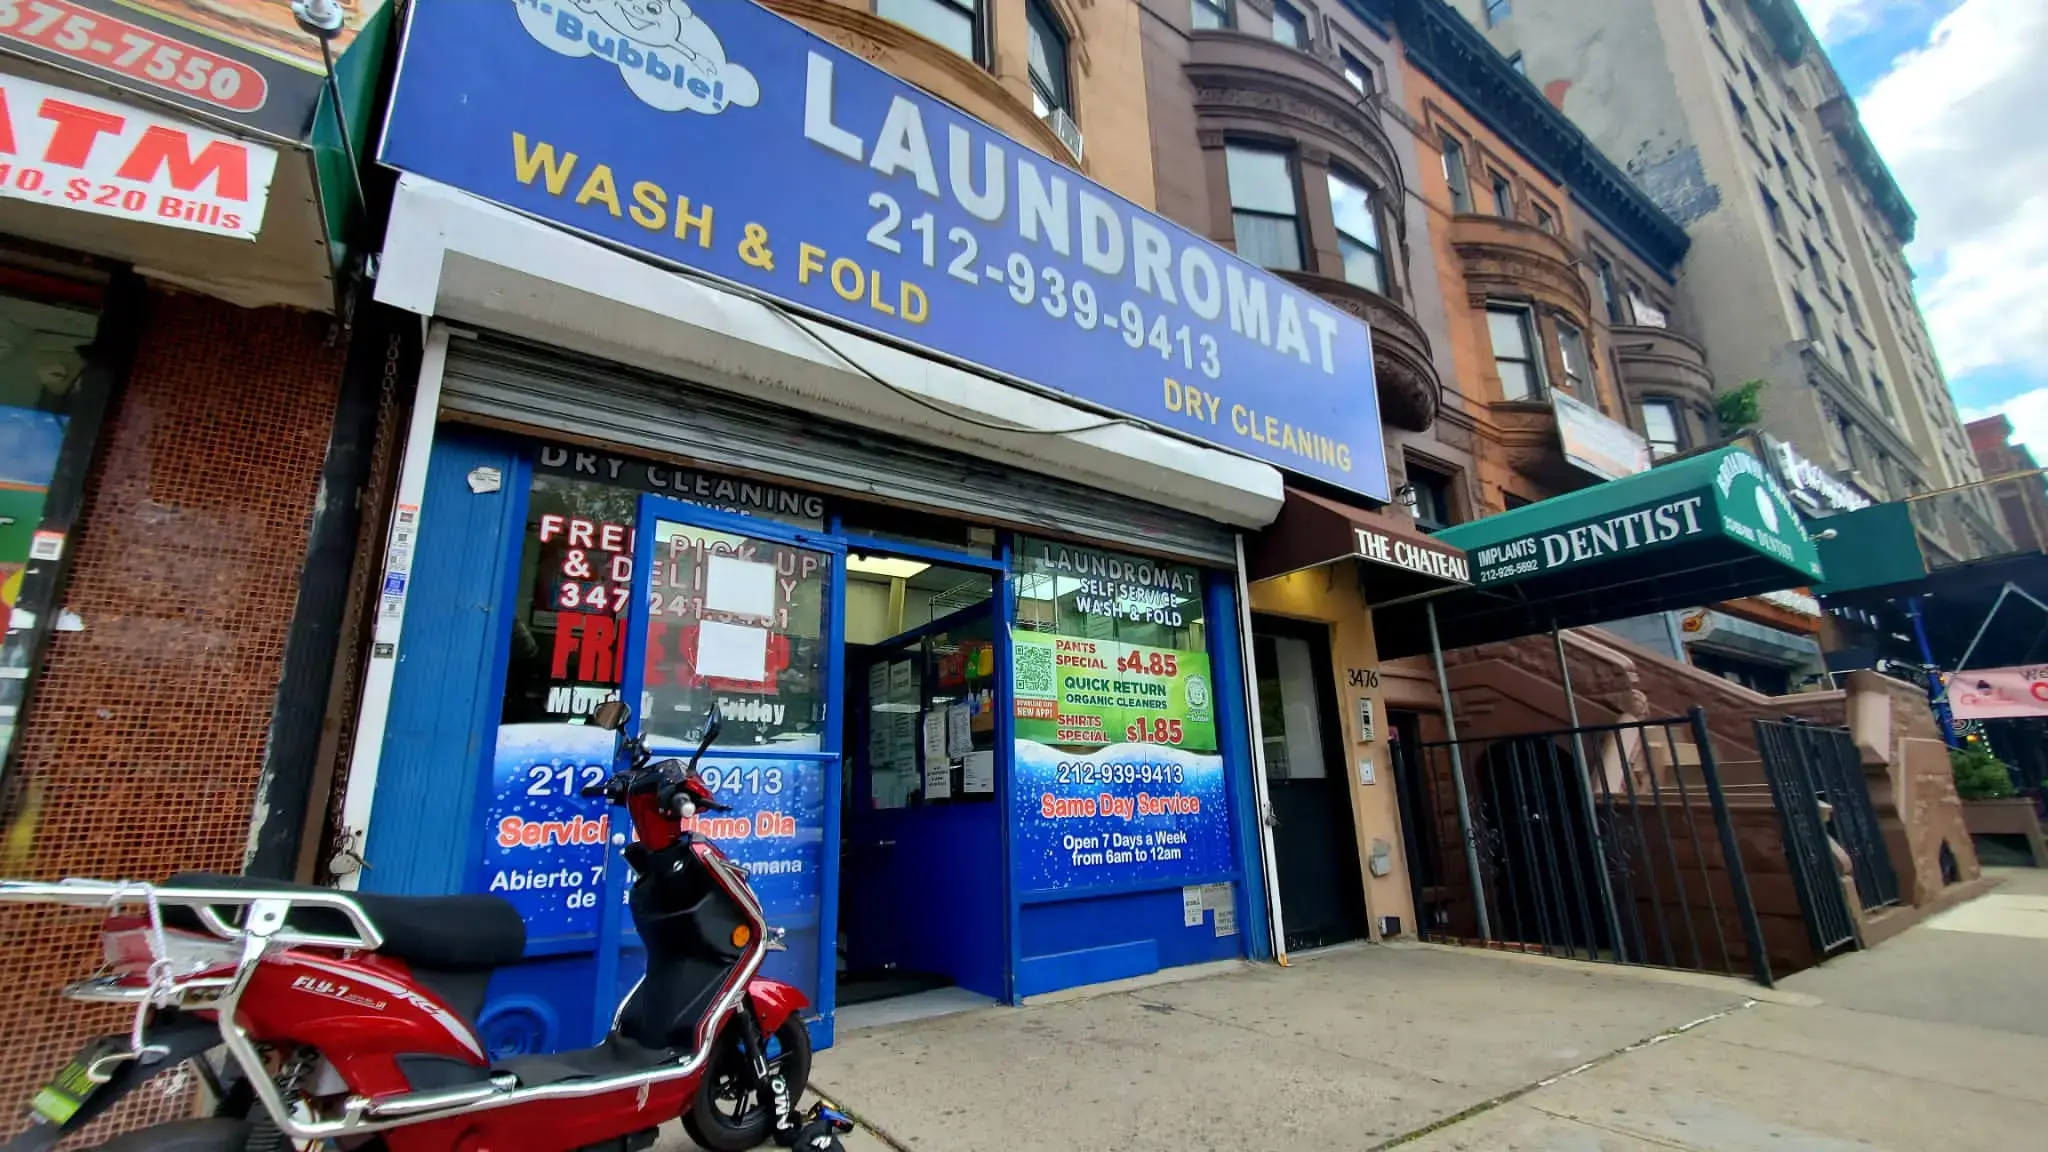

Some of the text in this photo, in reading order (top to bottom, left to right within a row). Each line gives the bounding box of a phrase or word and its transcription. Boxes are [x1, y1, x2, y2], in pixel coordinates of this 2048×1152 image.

[554, 7, 725, 112] Bubble!
[0, 87, 249, 202] TM
[64, 176, 148, 213] $20
[157, 195, 242, 231] Bills
[803, 49, 1339, 376] LAUNDROMAT
[512, 131, 929, 325] WASH & FOLD
[865, 191, 1223, 380] 212-939-9413
[1162, 376, 1353, 473] DRY CLEANING
[540, 446, 627, 480] DRY
[646, 464, 826, 519] CLEANING
[540, 513, 635, 553] FRE
[776, 550, 819, 579] UP
[1541, 496, 1702, 569] DENTIST
[562, 550, 592, 579] &
[1354, 527, 1470, 582] THE CHATEAU
[1478, 537, 1538, 568] IMPLANTS
[1043, 546, 1194, 594] LAUNDROMAT
[1079, 577, 1178, 609] SELF SERVICE
[1075, 596, 1183, 628] WASH & FOLD
[1055, 639, 1097, 655] PANTS
[1055, 649, 1178, 678] SPECIAL $4.85
[1347, 667, 1380, 689] 3476
[1064, 675, 1167, 697] QUICK RETURN
[1065, 693, 1115, 707] ORGANIC
[1116, 697, 1168, 710] CLEANERS
[1057, 714, 1102, 727] SHIRTS
[1057, 716, 1184, 744] SPECIAL $1.85
[1057, 762, 1185, 785] 212-939-9413
[1040, 790, 1201, 821] Same Day Service
[497, 814, 608, 848] Servici
[755, 808, 797, 839] Dia
[1063, 831, 1188, 851] Open 7 Days a Week
[1072, 847, 1182, 867] from 6am to 12am
[489, 867, 583, 893] Abierto
[590, 865, 604, 886] 7
[565, 888, 597, 909] de
